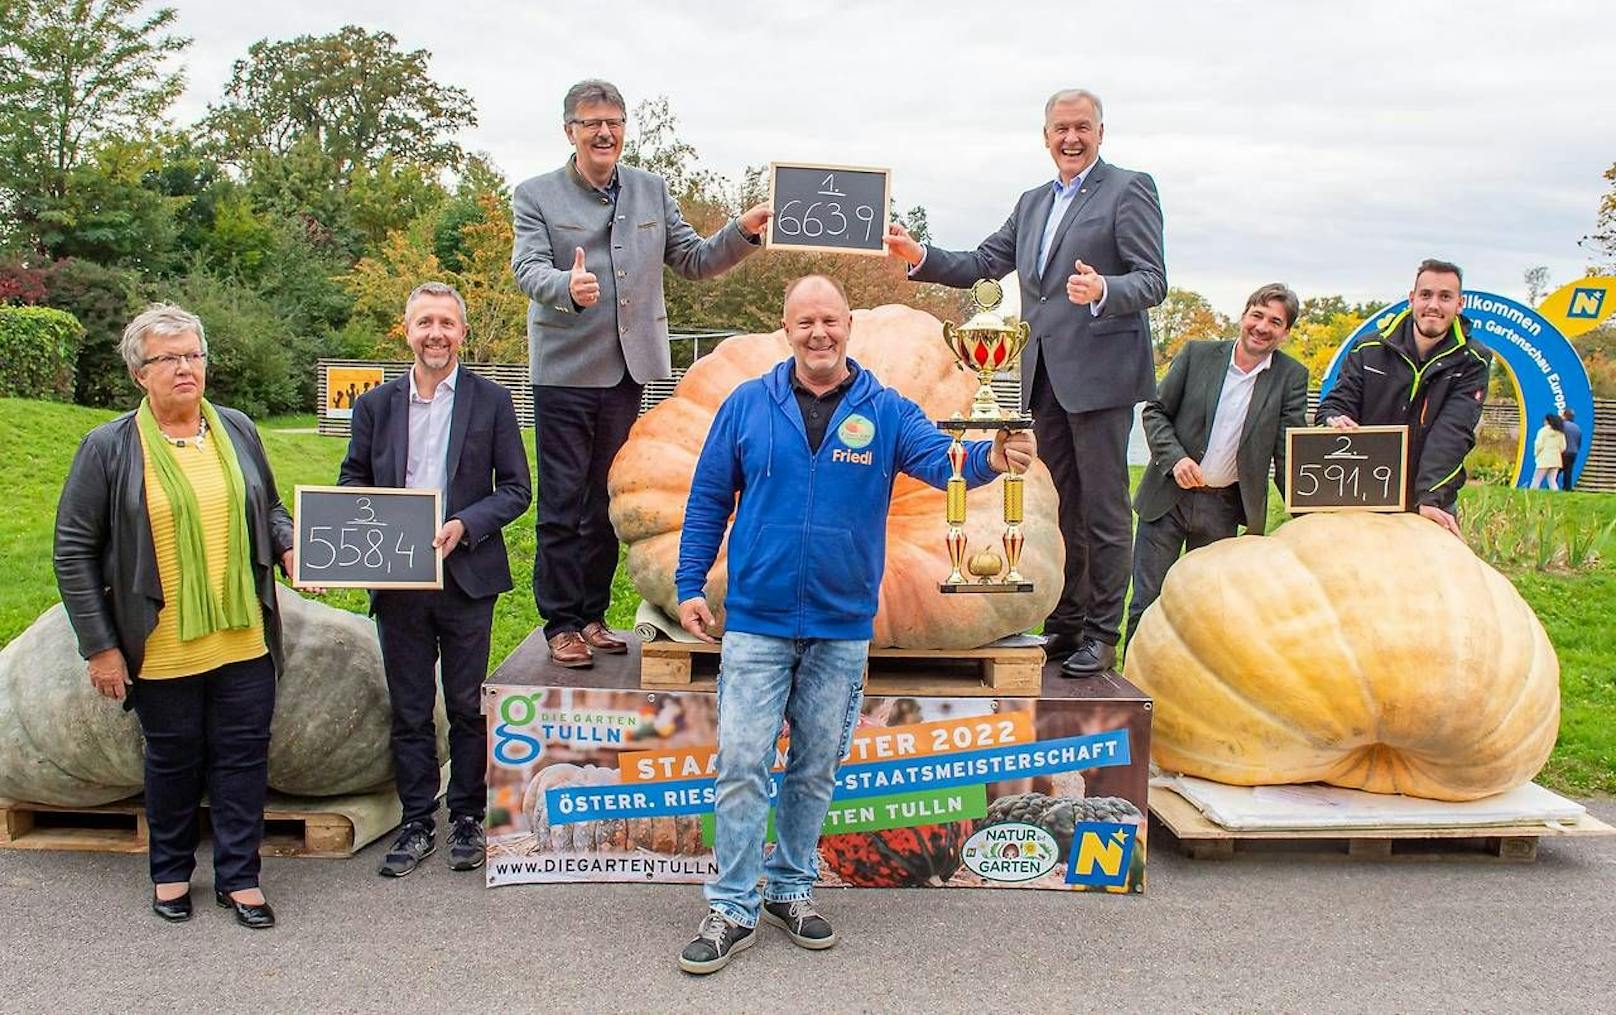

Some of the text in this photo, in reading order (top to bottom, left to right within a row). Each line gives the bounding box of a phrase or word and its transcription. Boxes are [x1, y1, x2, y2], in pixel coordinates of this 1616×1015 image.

[822, 173, 840, 193] 1.
[778, 200, 875, 242] 663,9
[1463, 294, 1541, 336] llkommen
[1485, 319, 1551, 374] Gartenschau
[832, 448, 872, 465] Friedl
[1331, 436, 1357, 456] 2.
[1297, 464, 1392, 501] 591,9
[306, 526, 415, 574] 558,4
[542, 713, 636, 726] DIE GARTEN
[542, 725, 620, 743] TULLN
[931, 721, 1016, 752] 2022
[559, 792, 656, 814] ÖSTERR.
[886, 797, 963, 819] TULLN
[986, 829, 1036, 841] NATUR
[979, 861, 1041, 873] GARTEN
